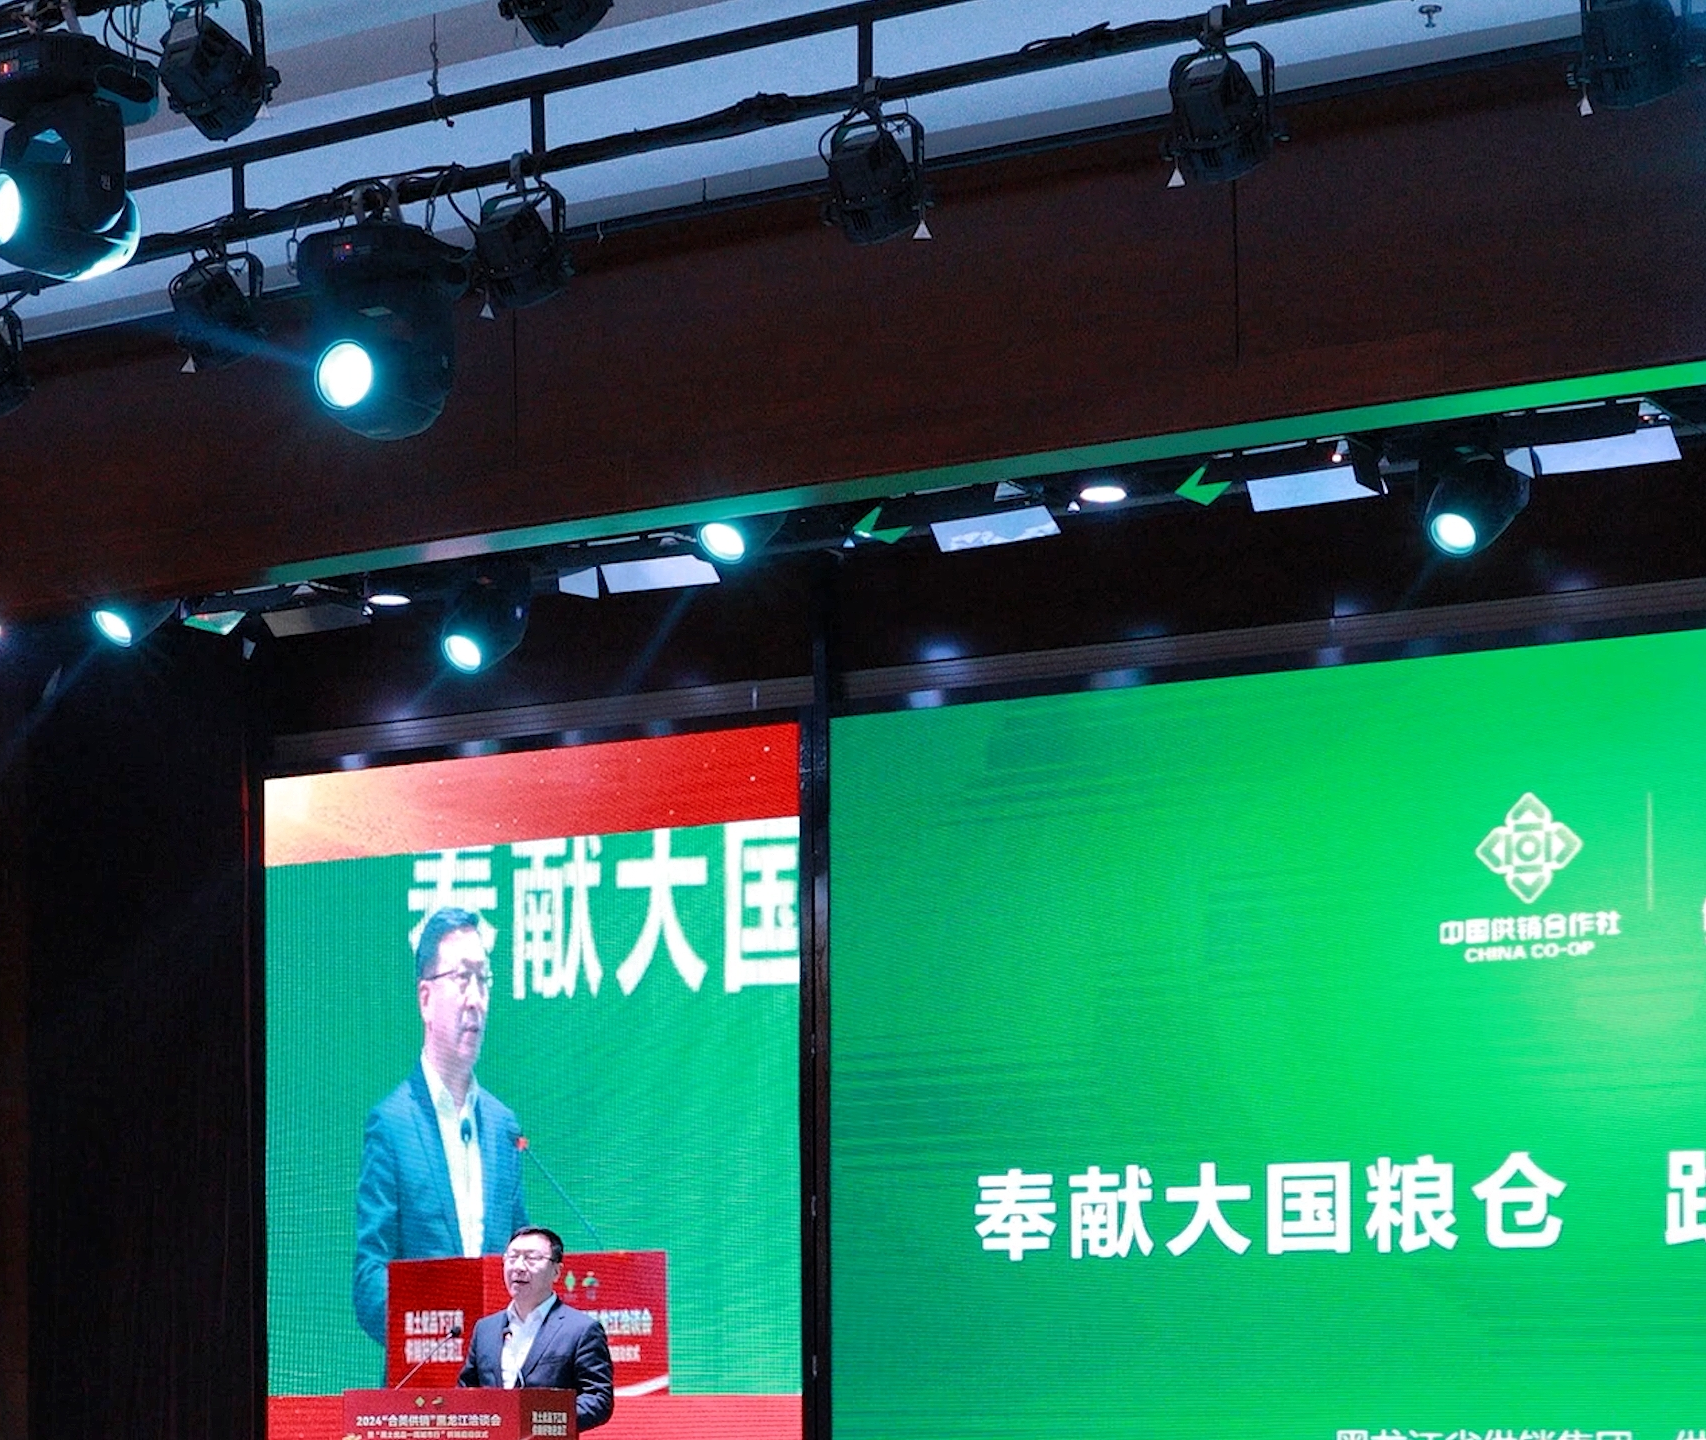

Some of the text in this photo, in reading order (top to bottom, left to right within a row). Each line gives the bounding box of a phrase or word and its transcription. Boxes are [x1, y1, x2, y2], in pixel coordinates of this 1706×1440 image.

[1439, 911, 1621, 945] 中国供销合作社
[1464, 940, 1595, 963] CHINA CO-OP
[974, 1151, 1567, 1262] 奉献大国粮仓
